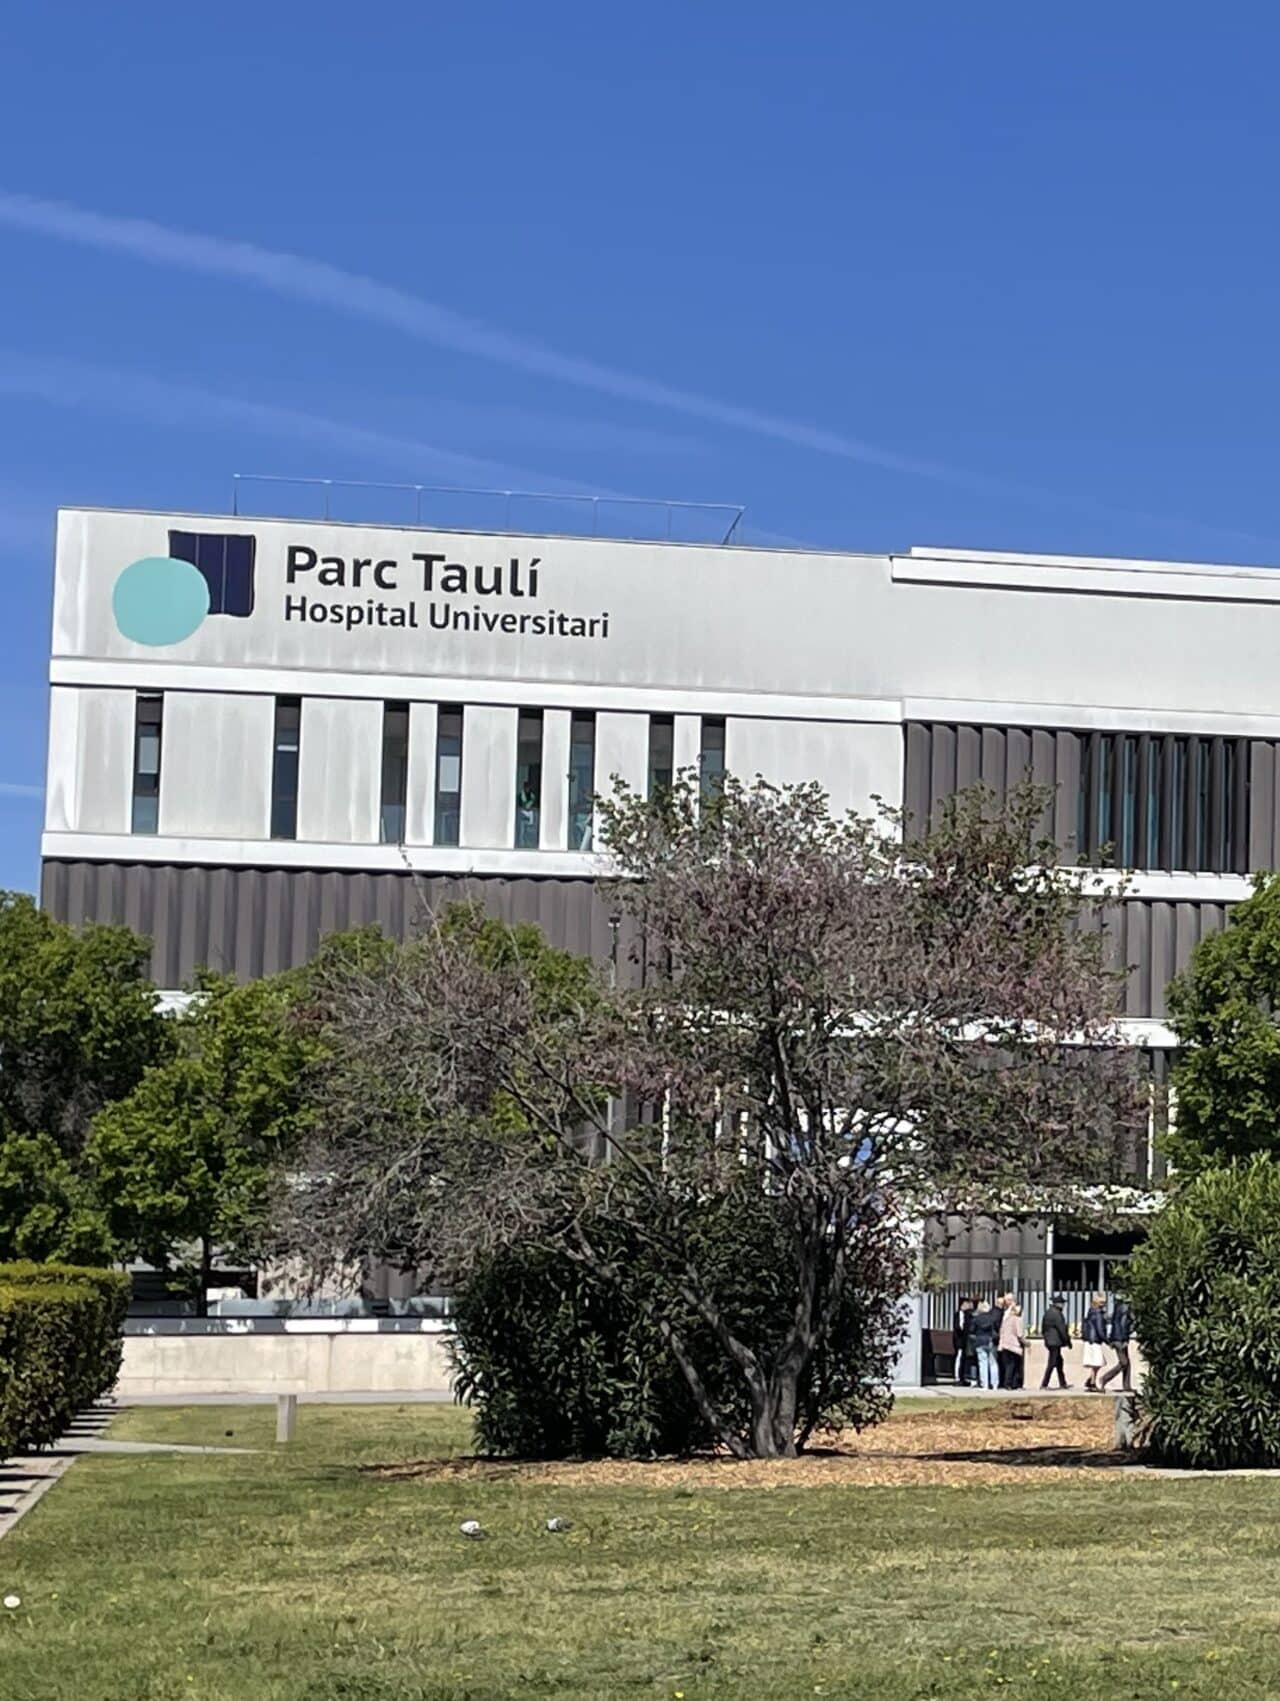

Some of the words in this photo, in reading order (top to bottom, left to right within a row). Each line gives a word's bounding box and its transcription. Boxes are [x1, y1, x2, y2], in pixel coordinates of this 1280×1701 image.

[286, 545, 397, 590] Parc
[412, 552, 541, 598] Taulí
[285, 594, 418, 631] Hospital
[429, 602, 609, 639] Universitari
